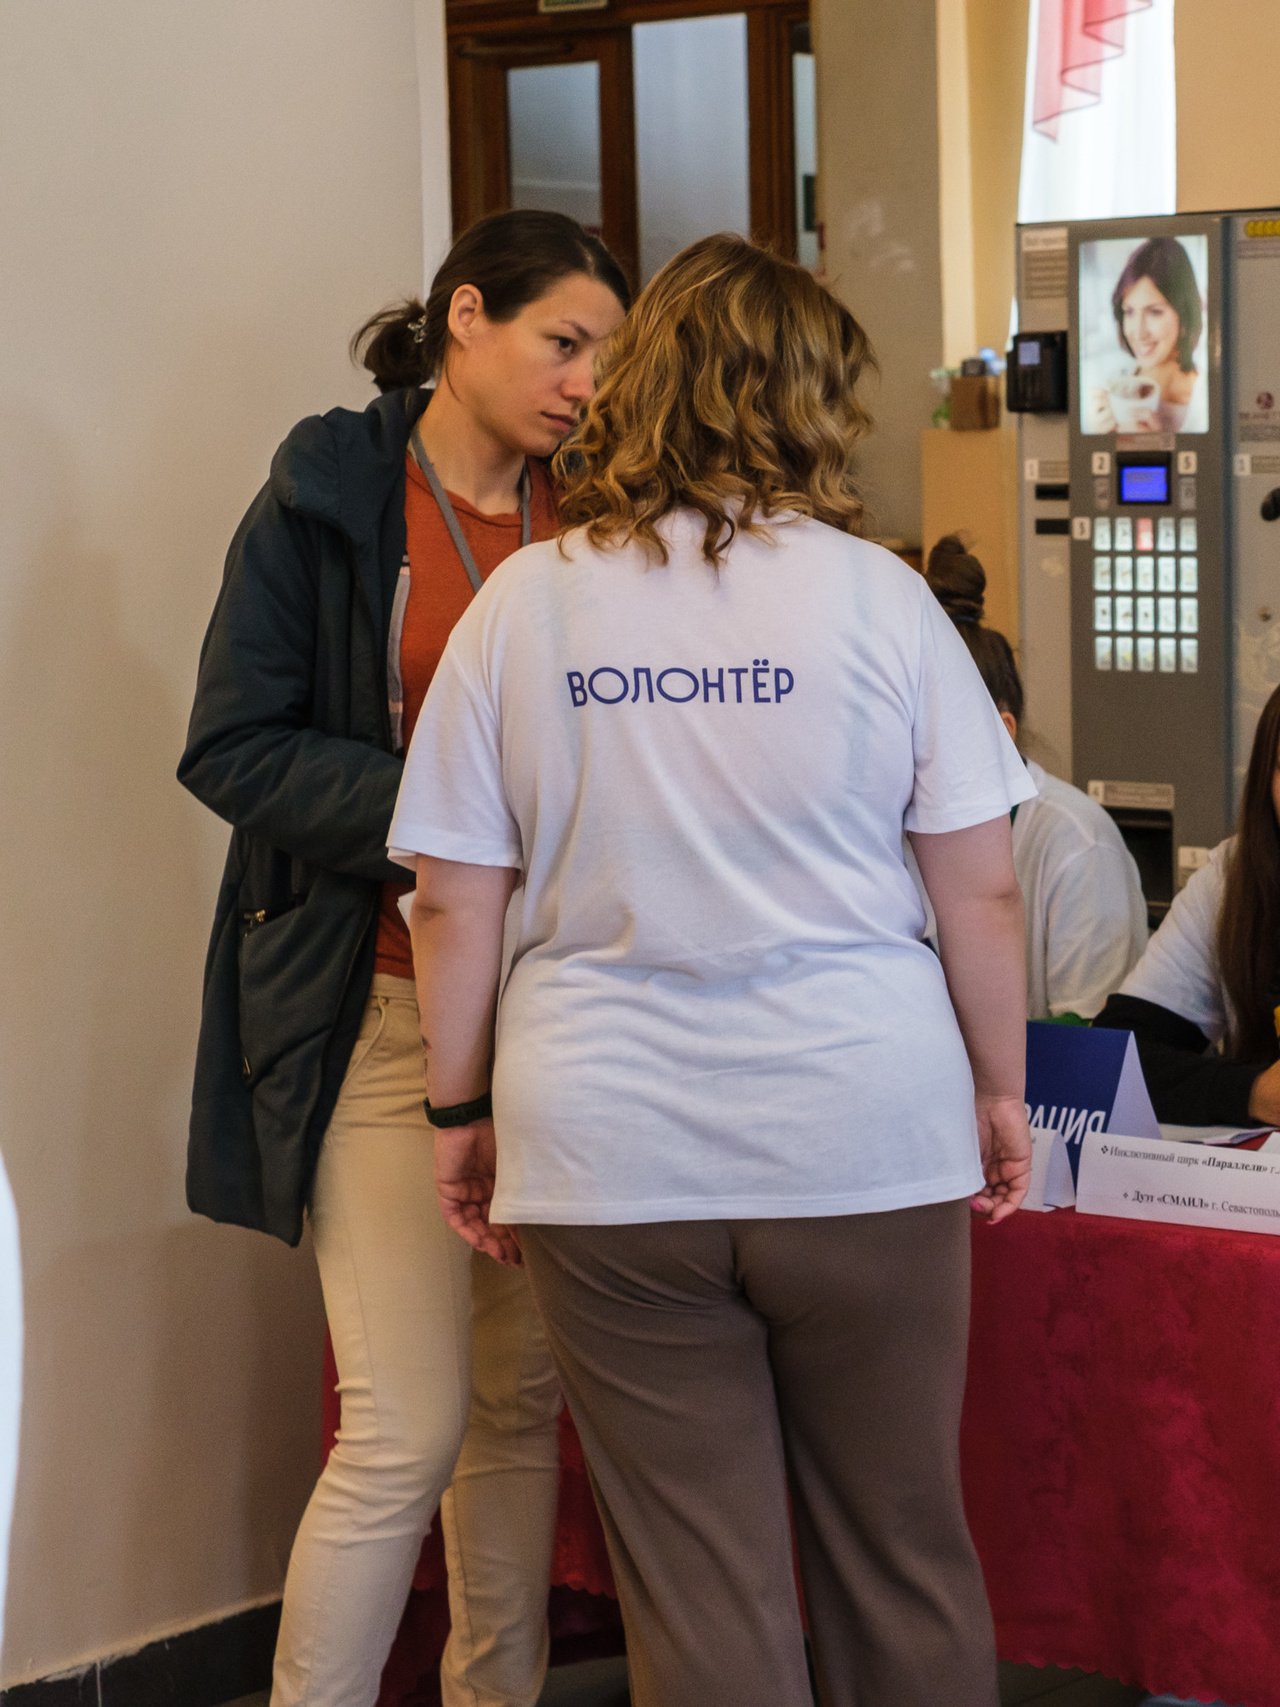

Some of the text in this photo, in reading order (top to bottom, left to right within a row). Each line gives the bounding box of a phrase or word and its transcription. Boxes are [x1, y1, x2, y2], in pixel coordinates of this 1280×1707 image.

[566, 658, 794, 707] ВОЛОНТЁР
[1110, 1146, 1175, 1163] Инклюзивный
[1177, 1156, 1199, 1167] цирк
[1202, 1157, 1268, 1173] «Параллели»
[1221, 1201, 1280, 1218] Севастополь
